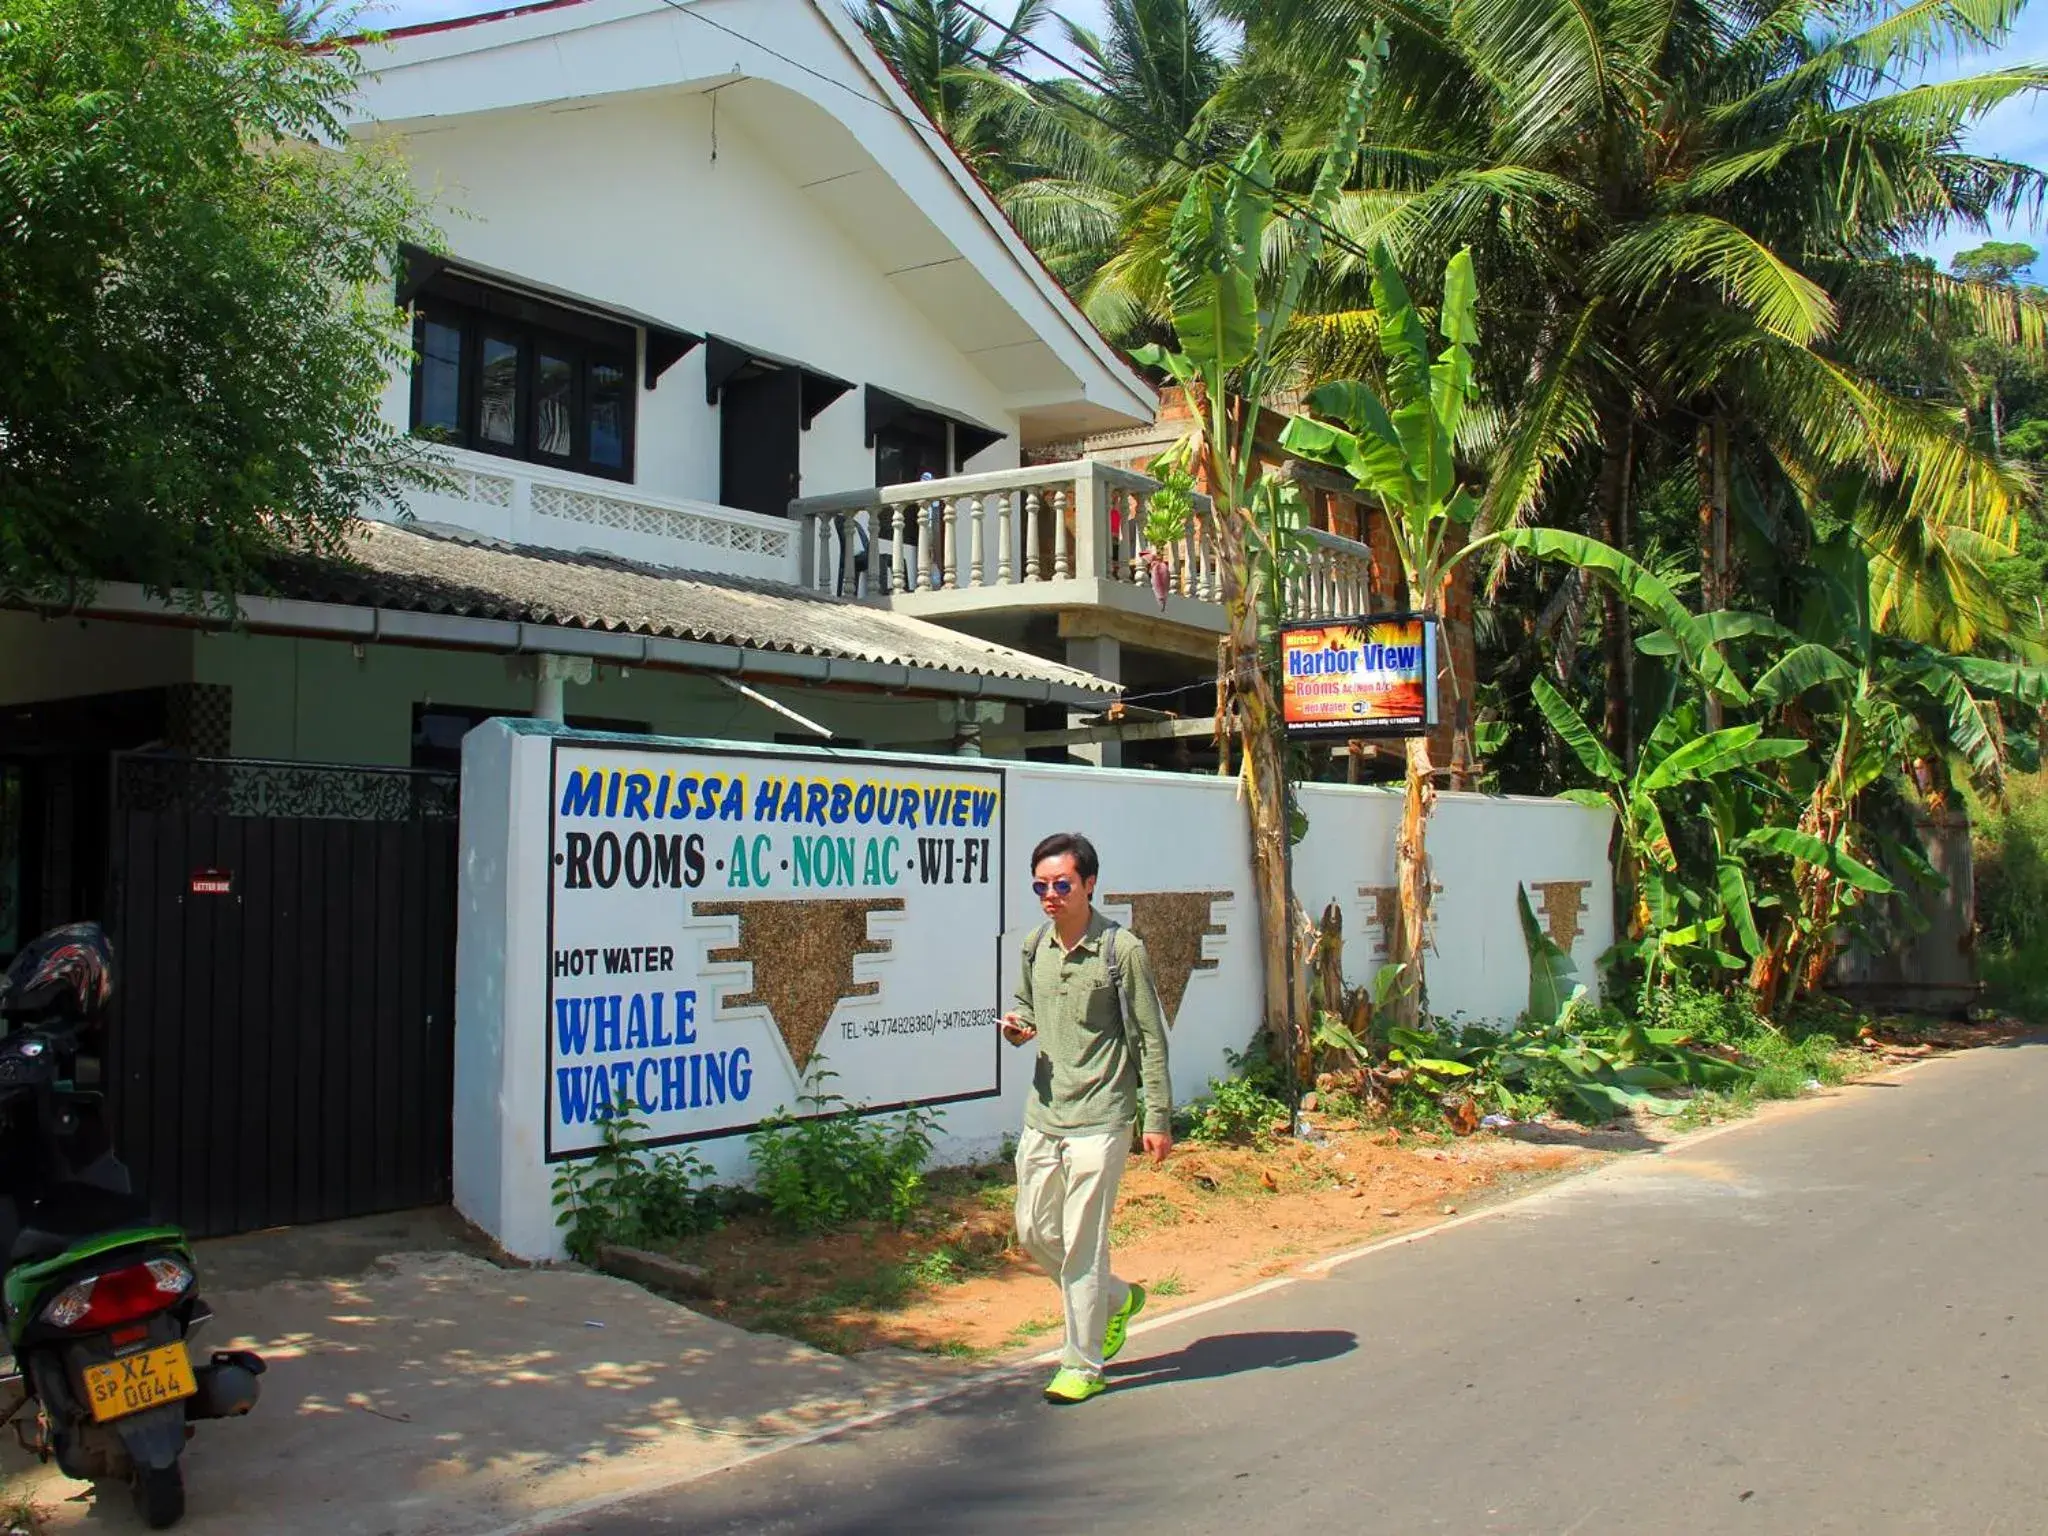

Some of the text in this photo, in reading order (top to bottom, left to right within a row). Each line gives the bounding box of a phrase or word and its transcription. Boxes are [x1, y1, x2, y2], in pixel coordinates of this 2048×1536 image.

[1289, 644, 1415, 675] Harbor View
[561, 769, 746, 821] MIRISSA
[564, 831, 990, 889] ROOMS AC NON AC WI-FI
[554, 946, 674, 977] HOT WATER
[555, 990, 697, 1056] WHALE
[556, 1047, 752, 1125] WATCHING
[95, 1380, 118, 1402] SP
[124, 1373, 180, 1408] 0044
